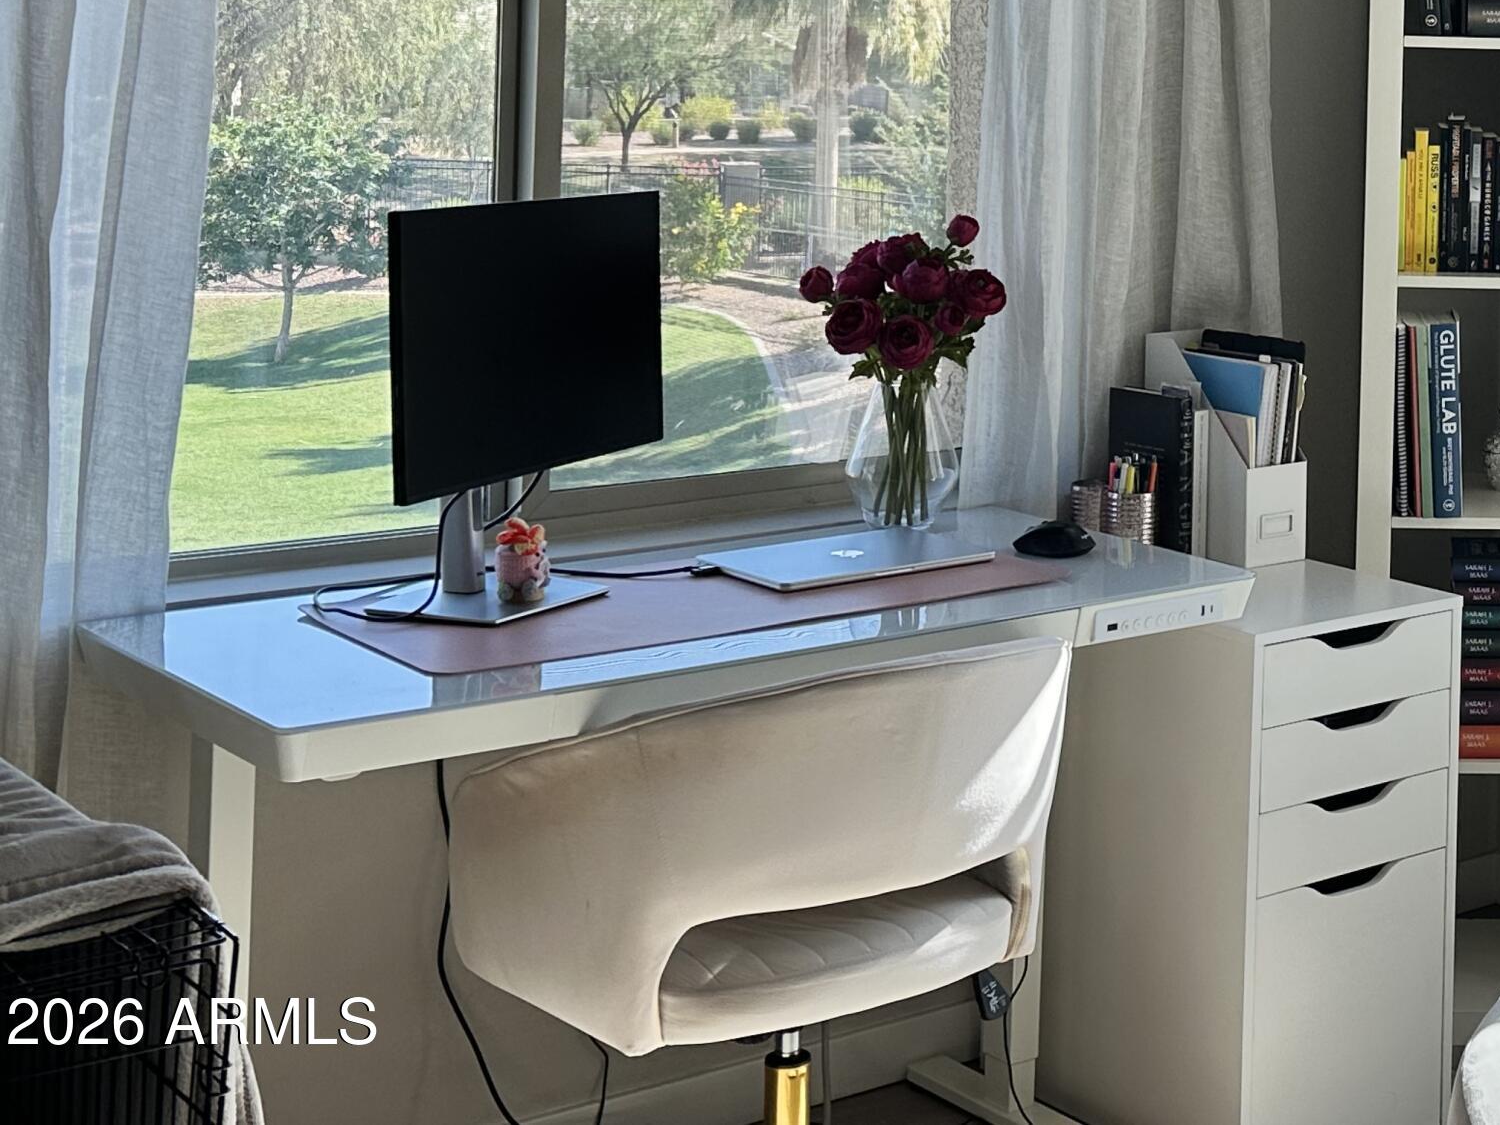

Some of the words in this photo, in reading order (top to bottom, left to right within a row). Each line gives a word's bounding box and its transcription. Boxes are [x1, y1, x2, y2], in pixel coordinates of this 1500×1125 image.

[1431, 153, 1439, 179] RUSS
[1439, 329, 1456, 391] GLUTE
[1441, 397, 1457, 434] LAB
